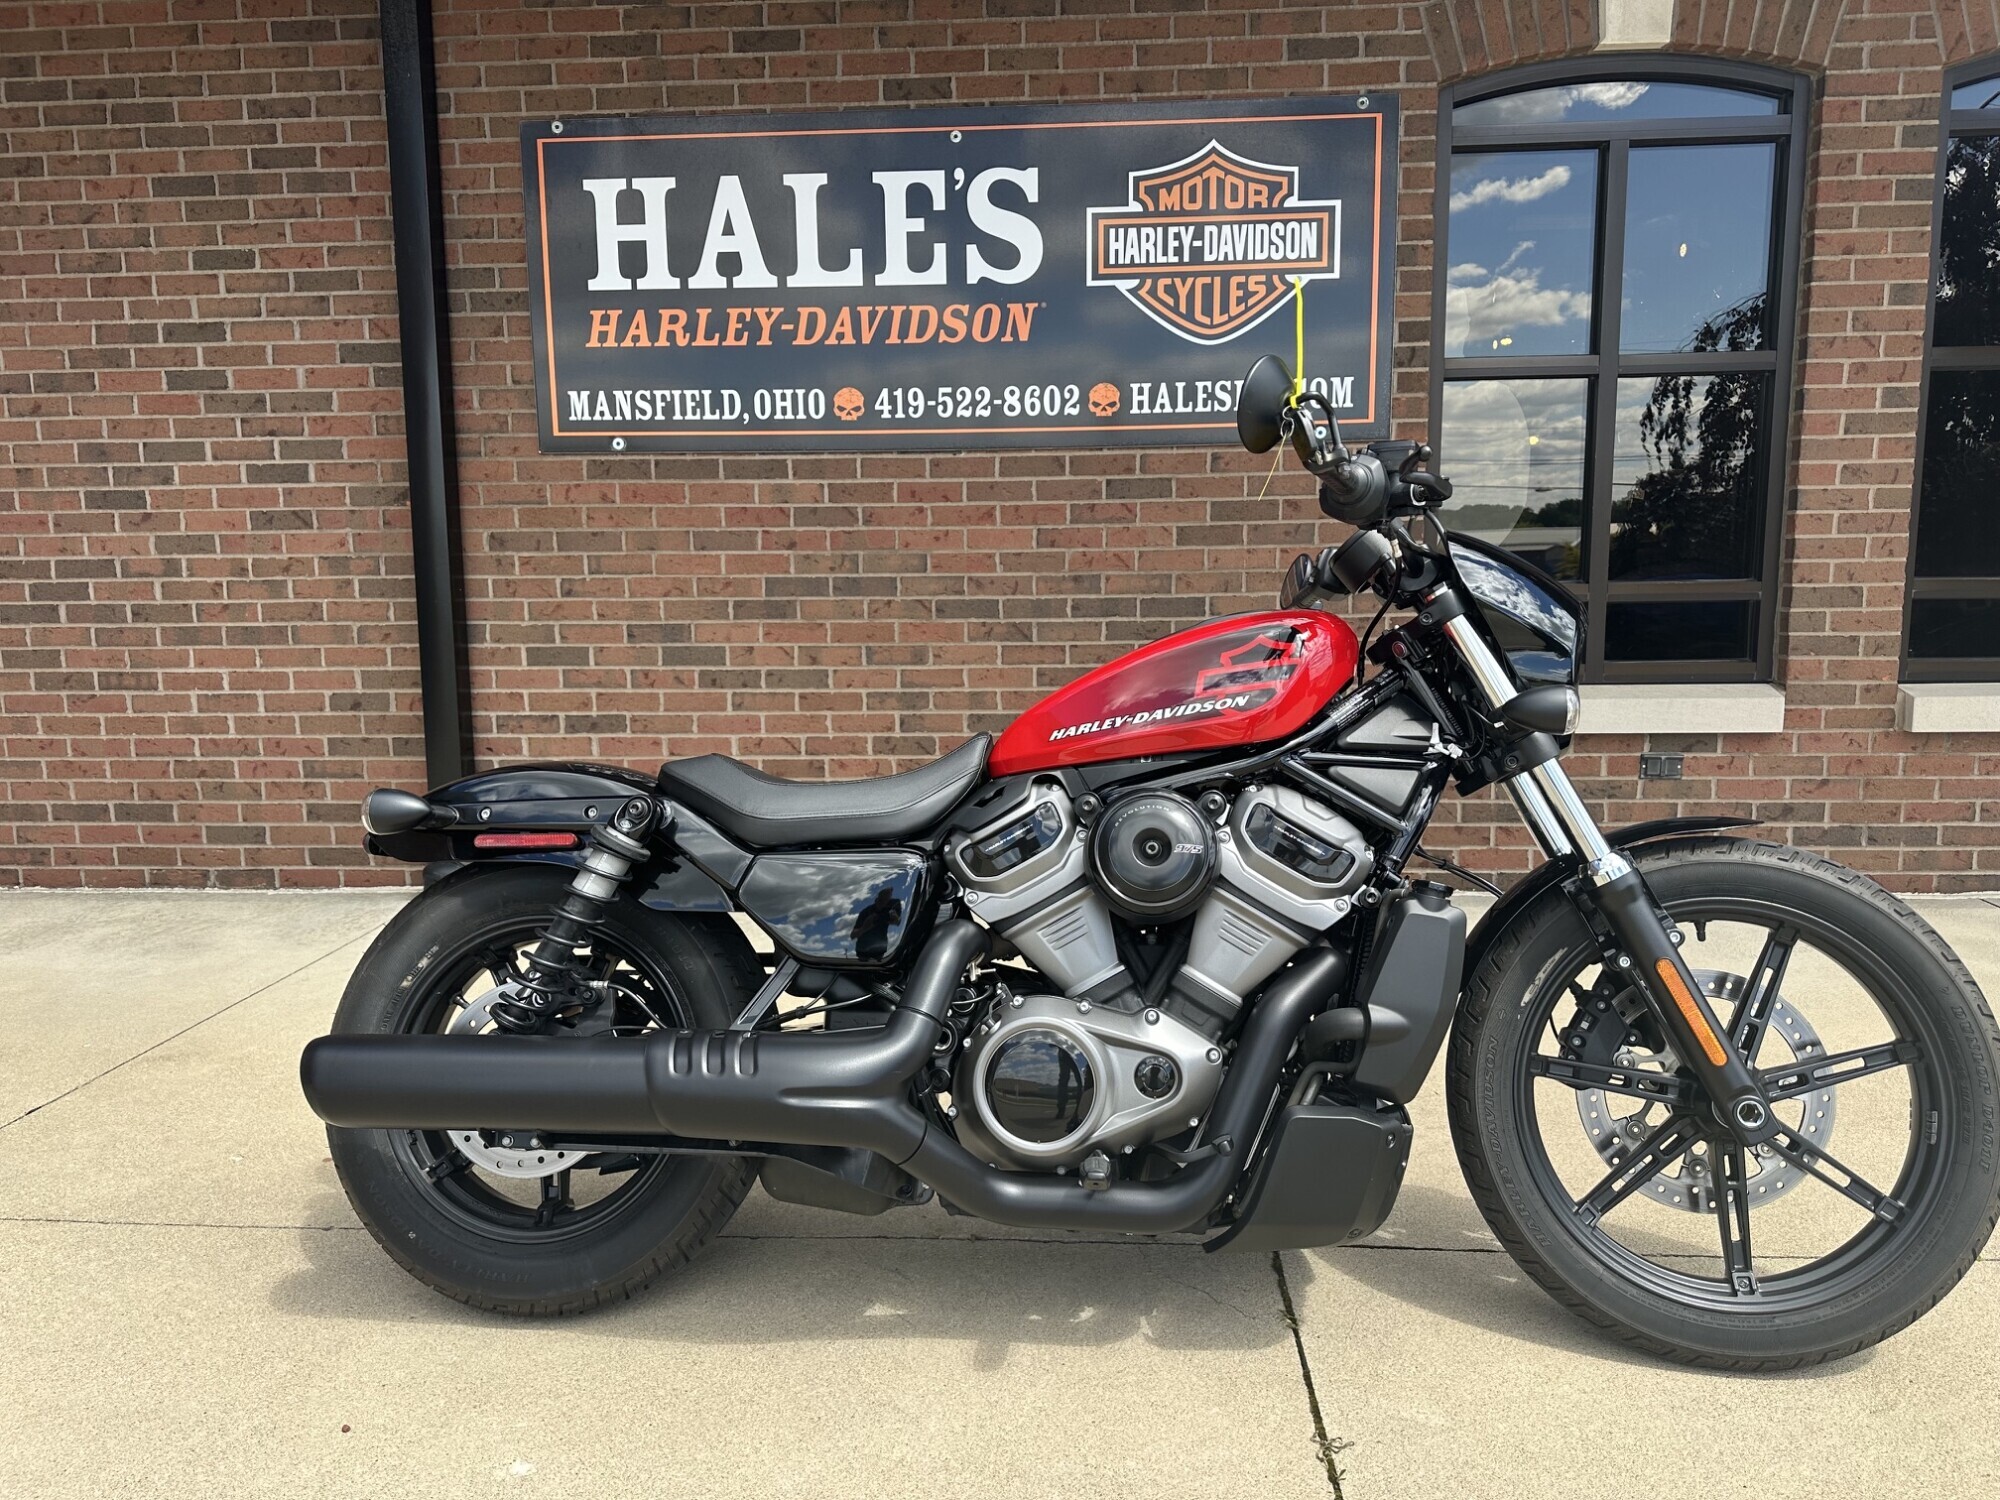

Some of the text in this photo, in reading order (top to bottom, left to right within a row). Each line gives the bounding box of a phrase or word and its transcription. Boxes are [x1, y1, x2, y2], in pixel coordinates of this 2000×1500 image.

[1159, 166, 1268, 211] MOTOR
[583, 167, 1044, 291] HALE'S
[1109, 221, 1318, 265] HARLEY-DAVIDSON
[1157, 275, 1267, 326] CYCLES
[585, 303, 1039, 348] HARLEY-DAVIDSON
[874, 384, 1081, 418] 419-522-8602
[1048, 694, 1250, 741] HARLEY-DAVIDSON
[1173, 843, 1204, 854] 975
[1951, 1005, 1992, 1096] DUNLOP
[1483, 1036, 1552, 1248] HARLEY-DAVIDSON
